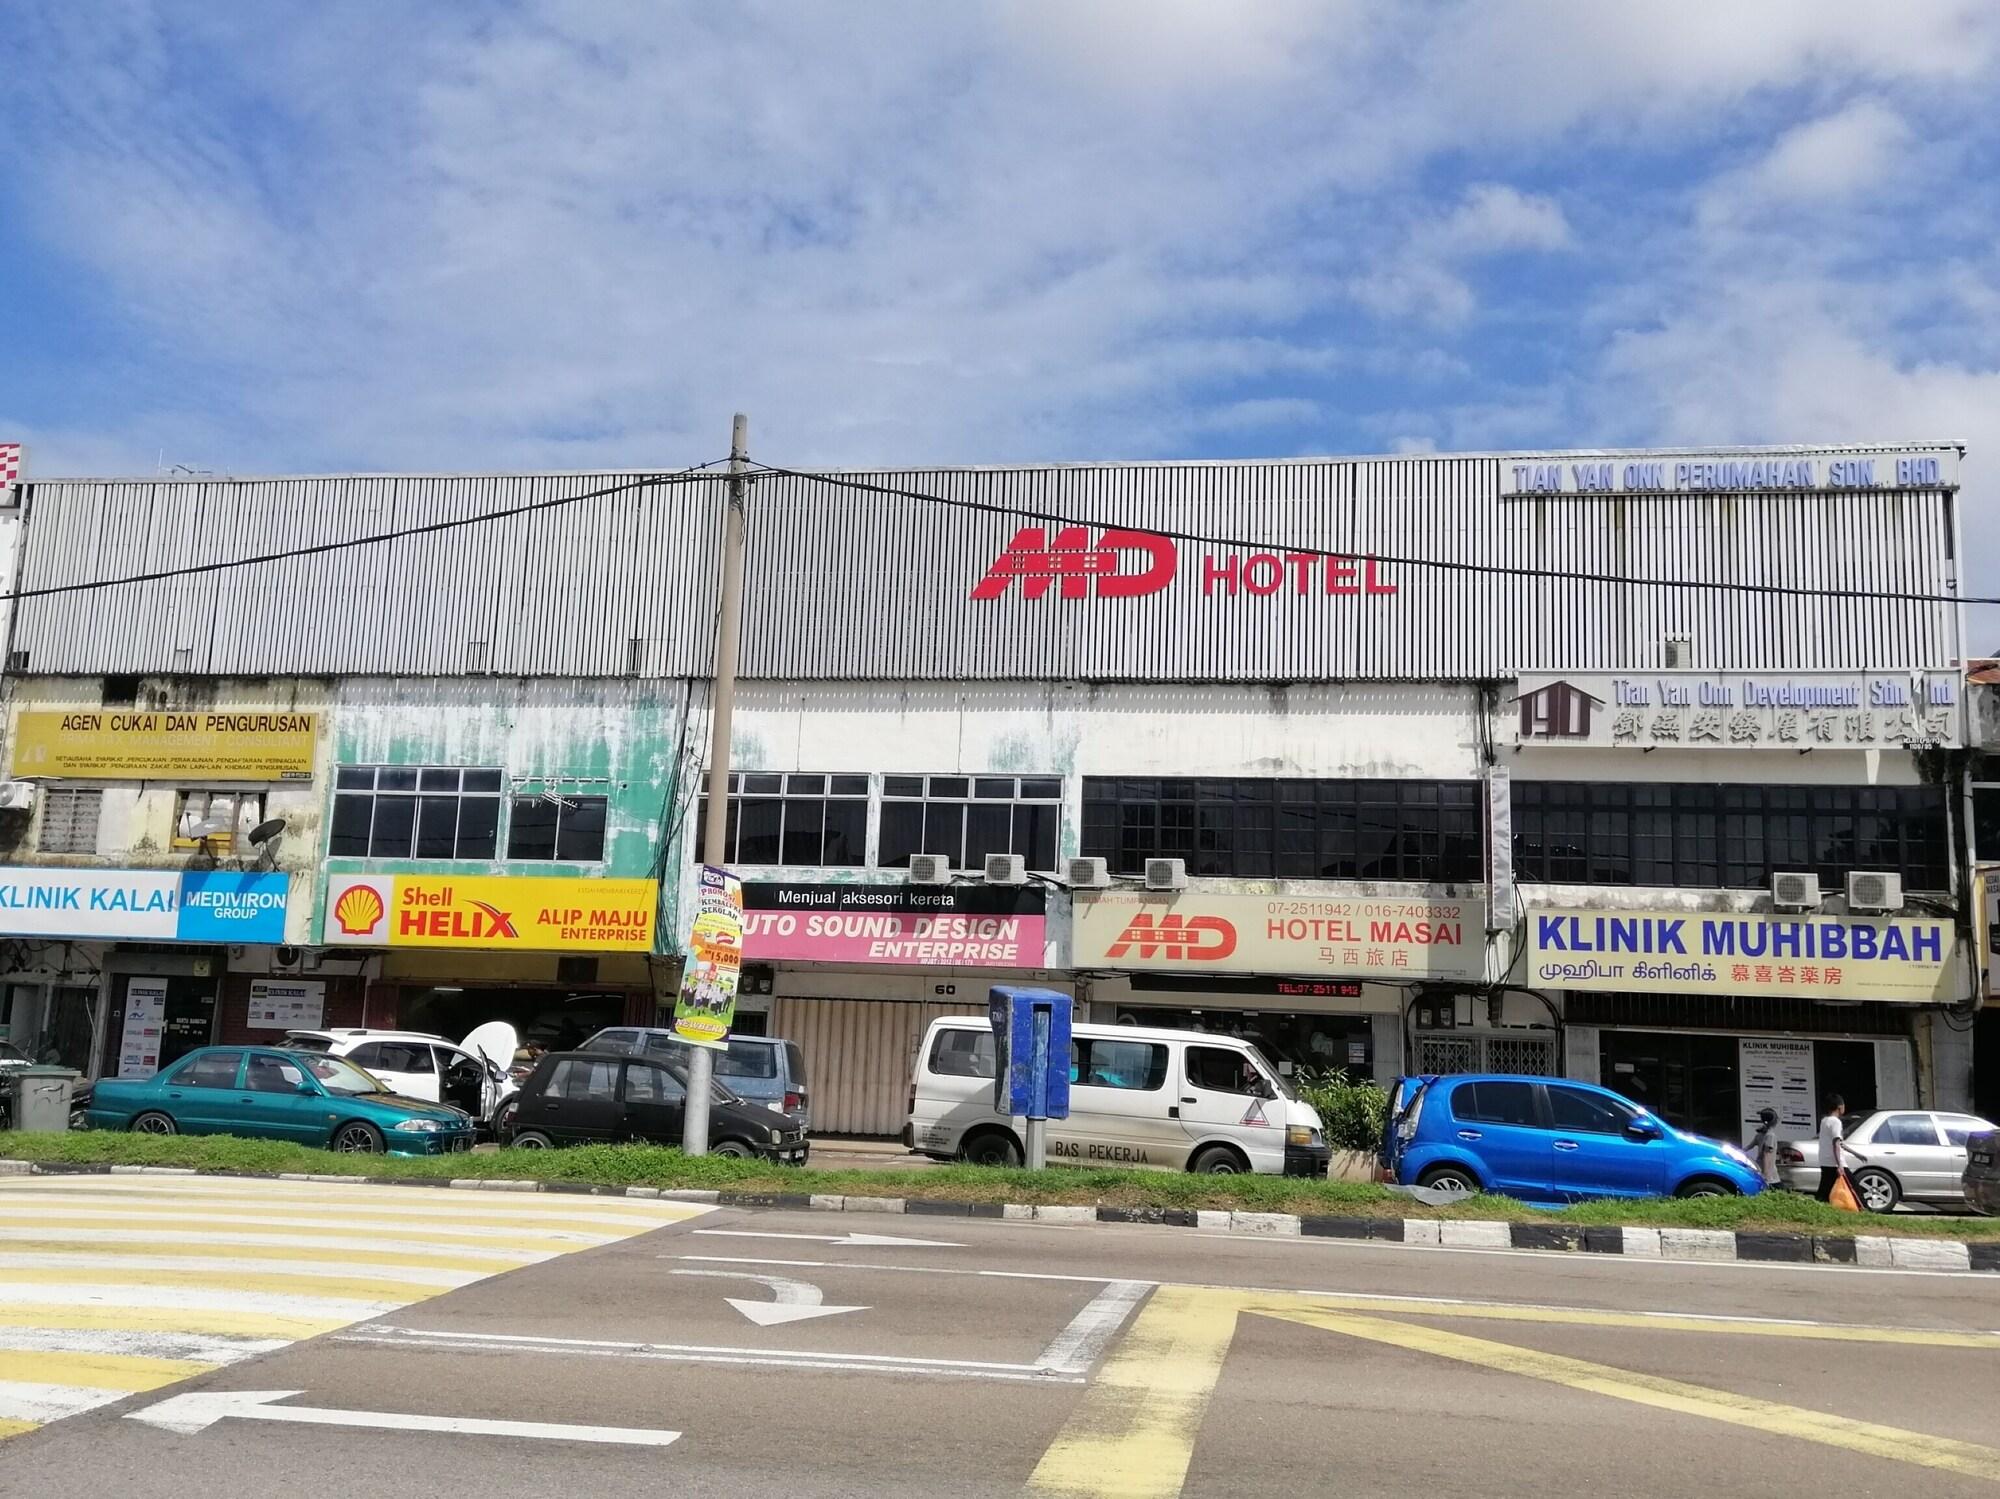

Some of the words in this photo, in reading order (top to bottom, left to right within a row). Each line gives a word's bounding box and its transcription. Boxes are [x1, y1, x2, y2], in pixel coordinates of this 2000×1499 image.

[1512, 464, 1562, 491] TIAN
[1572, 463, 1614, 491] YAN
[1623, 462, 1665, 490] ONN
[1675, 459, 1816, 491] PERUMAHAN
[1895, 457, 1946, 486] BHD.
[1204, 551, 1398, 597] HOTEL
[1612, 679, 1650, 706] Tian
[1657, 679, 1691, 706] Yan
[1699, 680, 1734, 706] Onn
[1743, 678, 1860, 711] Development
[61, 714, 101, 732] AGEN
[110, 715, 158, 732] CUKAI
[165, 715, 198, 732] DAN
[205, 715, 311, 733] PENGURUSAN
[0, 885, 80, 910] KLINIK
[185, 891, 286, 909] MEDIVIRON
[402, 886, 453, 907] Shell
[778, 890, 836, 906] Menjual
[842, 892, 904, 905] aksesori
[910, 893, 955, 906] kereta
[214, 908, 258, 919] GROUP
[537, 908, 583, 926] ALIP
[588, 909, 648, 927] MAJU
[701, 906, 738, 921] SEKOLAH
[1267, 902, 1351, 917] 07-2511942
[1364, 904, 1461, 919] 016-7403332
[400, 907, 518, 938] HELIX
[743, 914, 797, 936] UTO
[806, 915, 902, 938] SOUND
[913, 918, 1019, 941] DESIGN
[1267, 918, 1361, 942] HOTEL
[1370, 921, 1461, 945] MASAI
[560, 927, 647, 941] ENTERPRISE
[1538, 915, 1688, 954] KLINIK
[1702, 920, 1942, 962] MUHIBBAH
[869, 941, 1018, 960] ENTERPRISE
[1318, 947, 1408, 967] 马西旅店
[1632, 961, 1717, 981] கிளினிக்
[935, 984, 956, 995] 60
[1742, 1042, 1769, 1050] KLINIK
[1770, 1043, 1810, 1051] MUHIBBAH
[1055, 1141, 1079, 1157] BAS
[1089, 1144, 1149, 1164] PEKERJA
